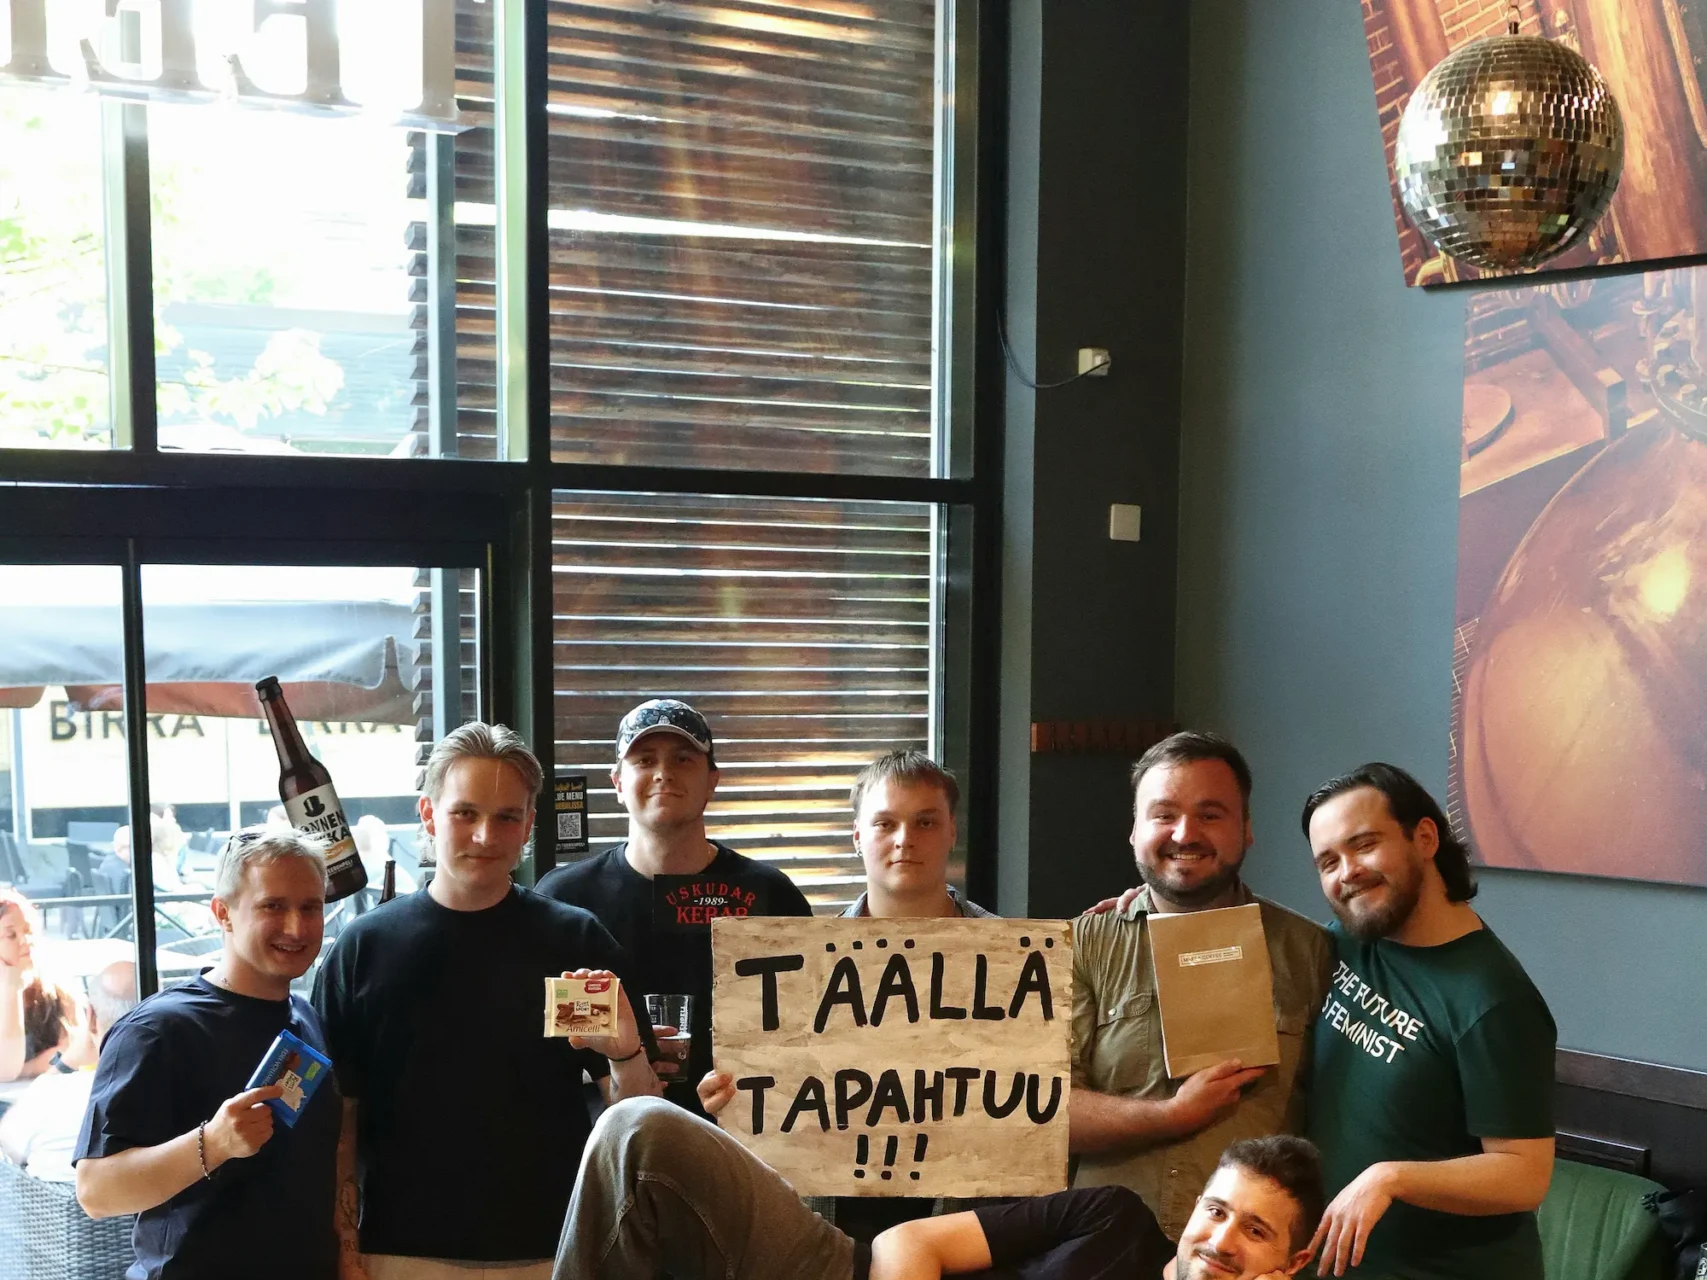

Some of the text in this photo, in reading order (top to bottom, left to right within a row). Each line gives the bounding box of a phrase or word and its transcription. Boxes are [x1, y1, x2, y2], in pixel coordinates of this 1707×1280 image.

[566, 791, 583, 800] MENU
[665, 882, 756, 907] USKUDAR
[735, 936, 1054, 1034] TÄÄLLÄ
[1332, 960, 1424, 1041] THE FUTURE
[1325, 1000, 1405, 1064] FEMINIST
[736, 1067, 1062, 1135] TAPAHTUU
